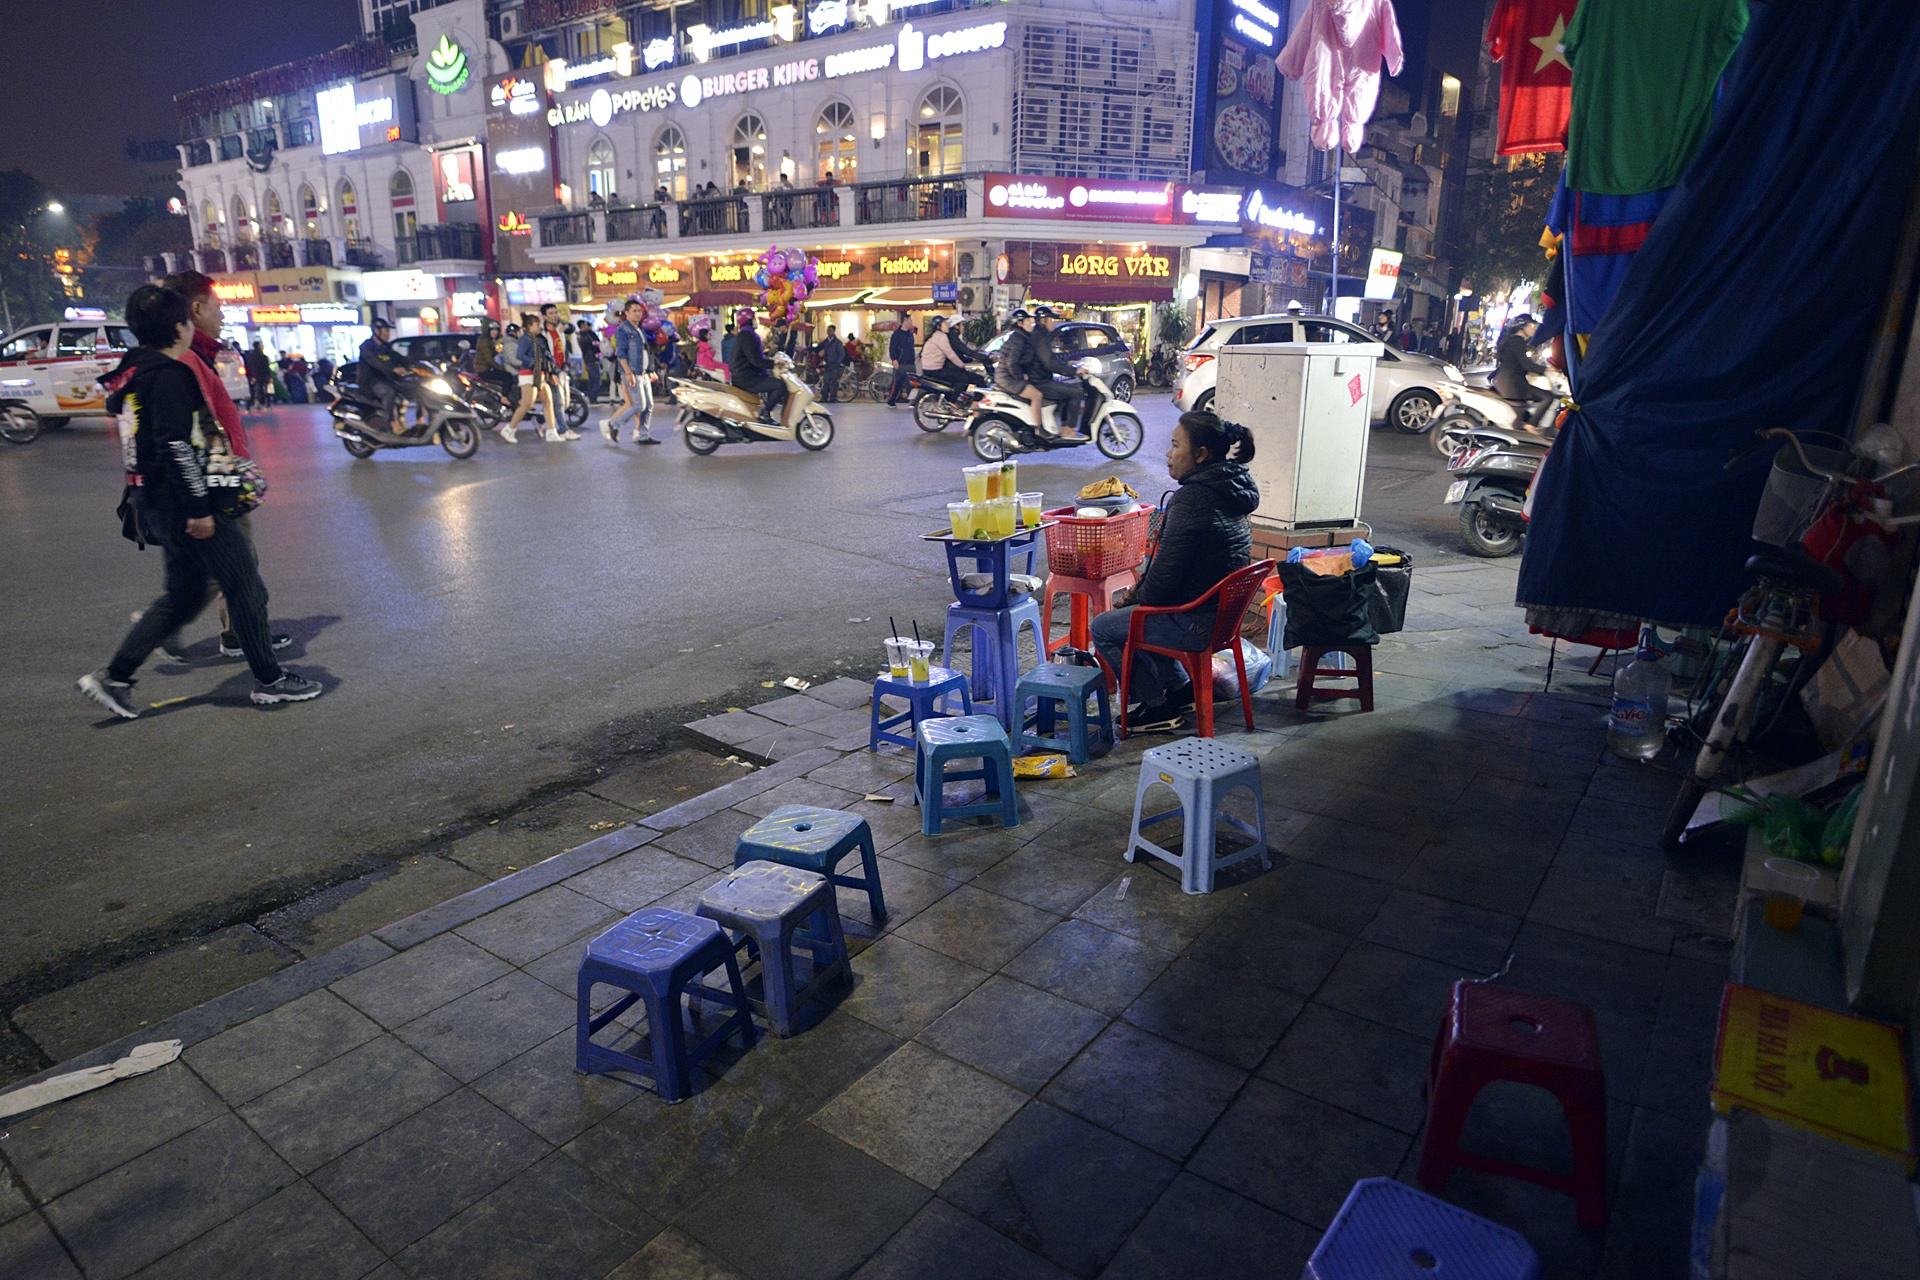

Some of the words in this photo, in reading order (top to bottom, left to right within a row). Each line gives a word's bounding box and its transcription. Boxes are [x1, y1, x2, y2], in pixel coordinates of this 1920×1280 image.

[702, 67, 770, 98] BURGER
[773, 58, 819, 87] KING
[547, 103, 566, 127] GÀ
[565, 100, 591, 123] RÁN
[711, 264, 741, 282] LONG
[880, 255, 928, 275] Fastfood
[1060, 254, 1119, 276] LONG
[1123, 252, 1170, 277] VÂN
[299, 276, 324, 286] GoPro
[595, 269, 638, 286] Ice-cream
[648, 266, 680, 284] Coffee
[1758, 1003, 1791, 1032] BIA
